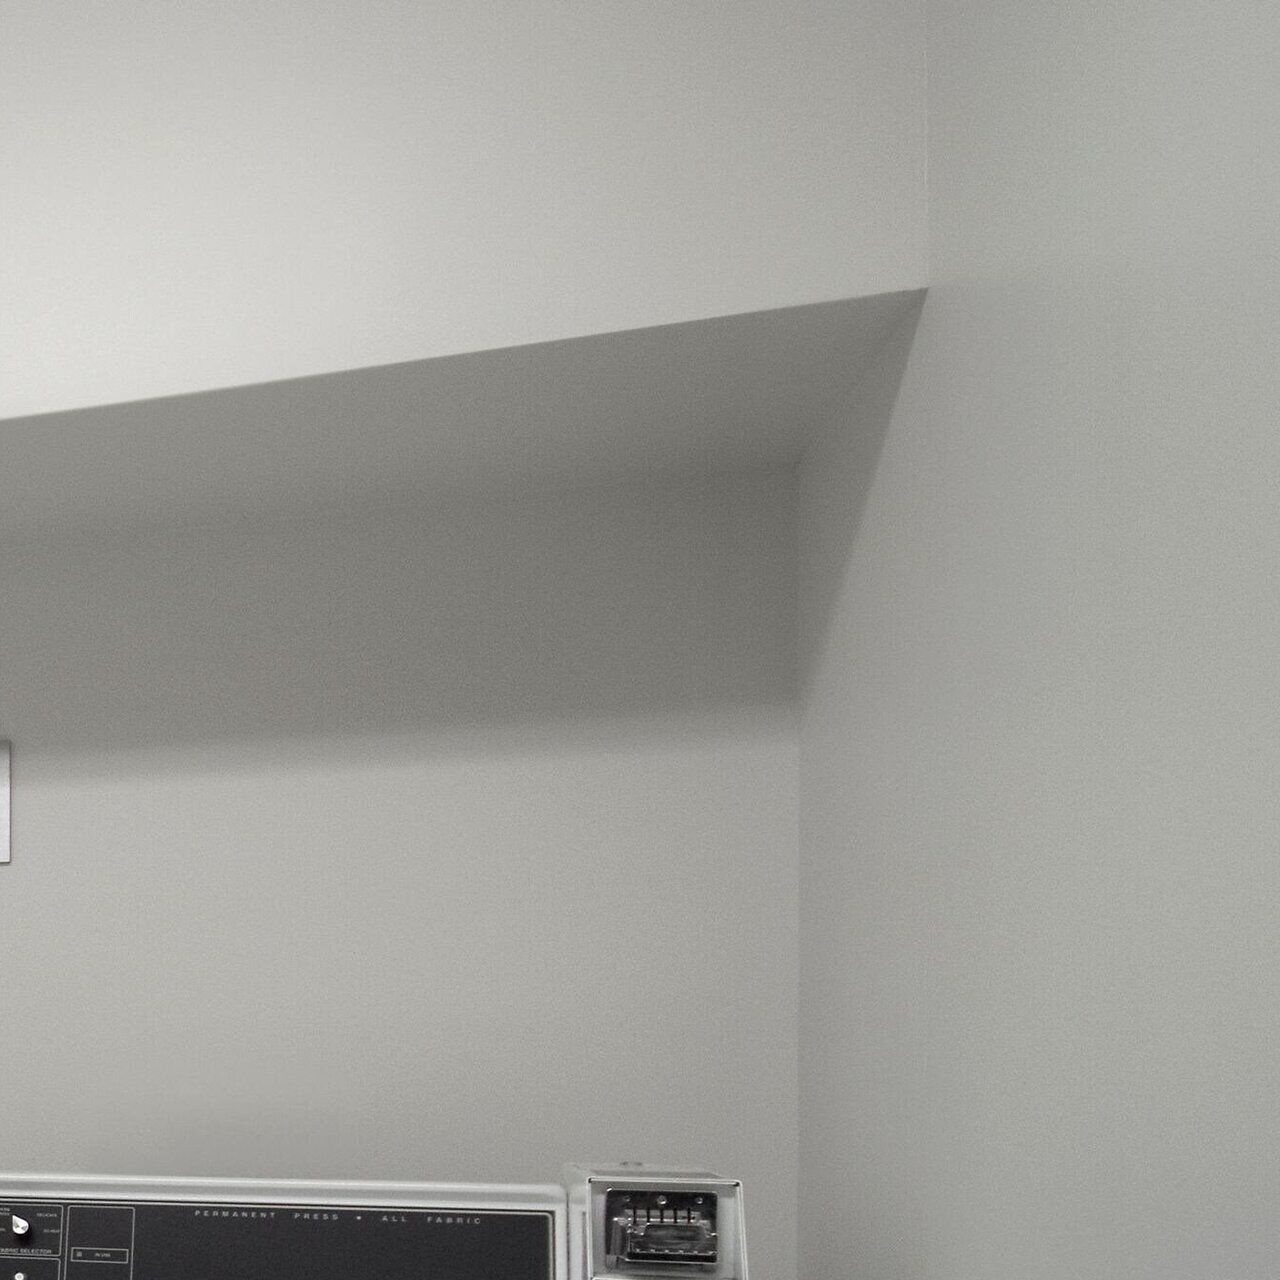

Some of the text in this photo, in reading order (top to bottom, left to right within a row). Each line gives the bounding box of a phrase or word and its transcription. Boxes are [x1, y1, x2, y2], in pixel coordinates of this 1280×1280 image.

[194, 1209, 481, 1225] PERMANENT PRESS ALL FABRIC
